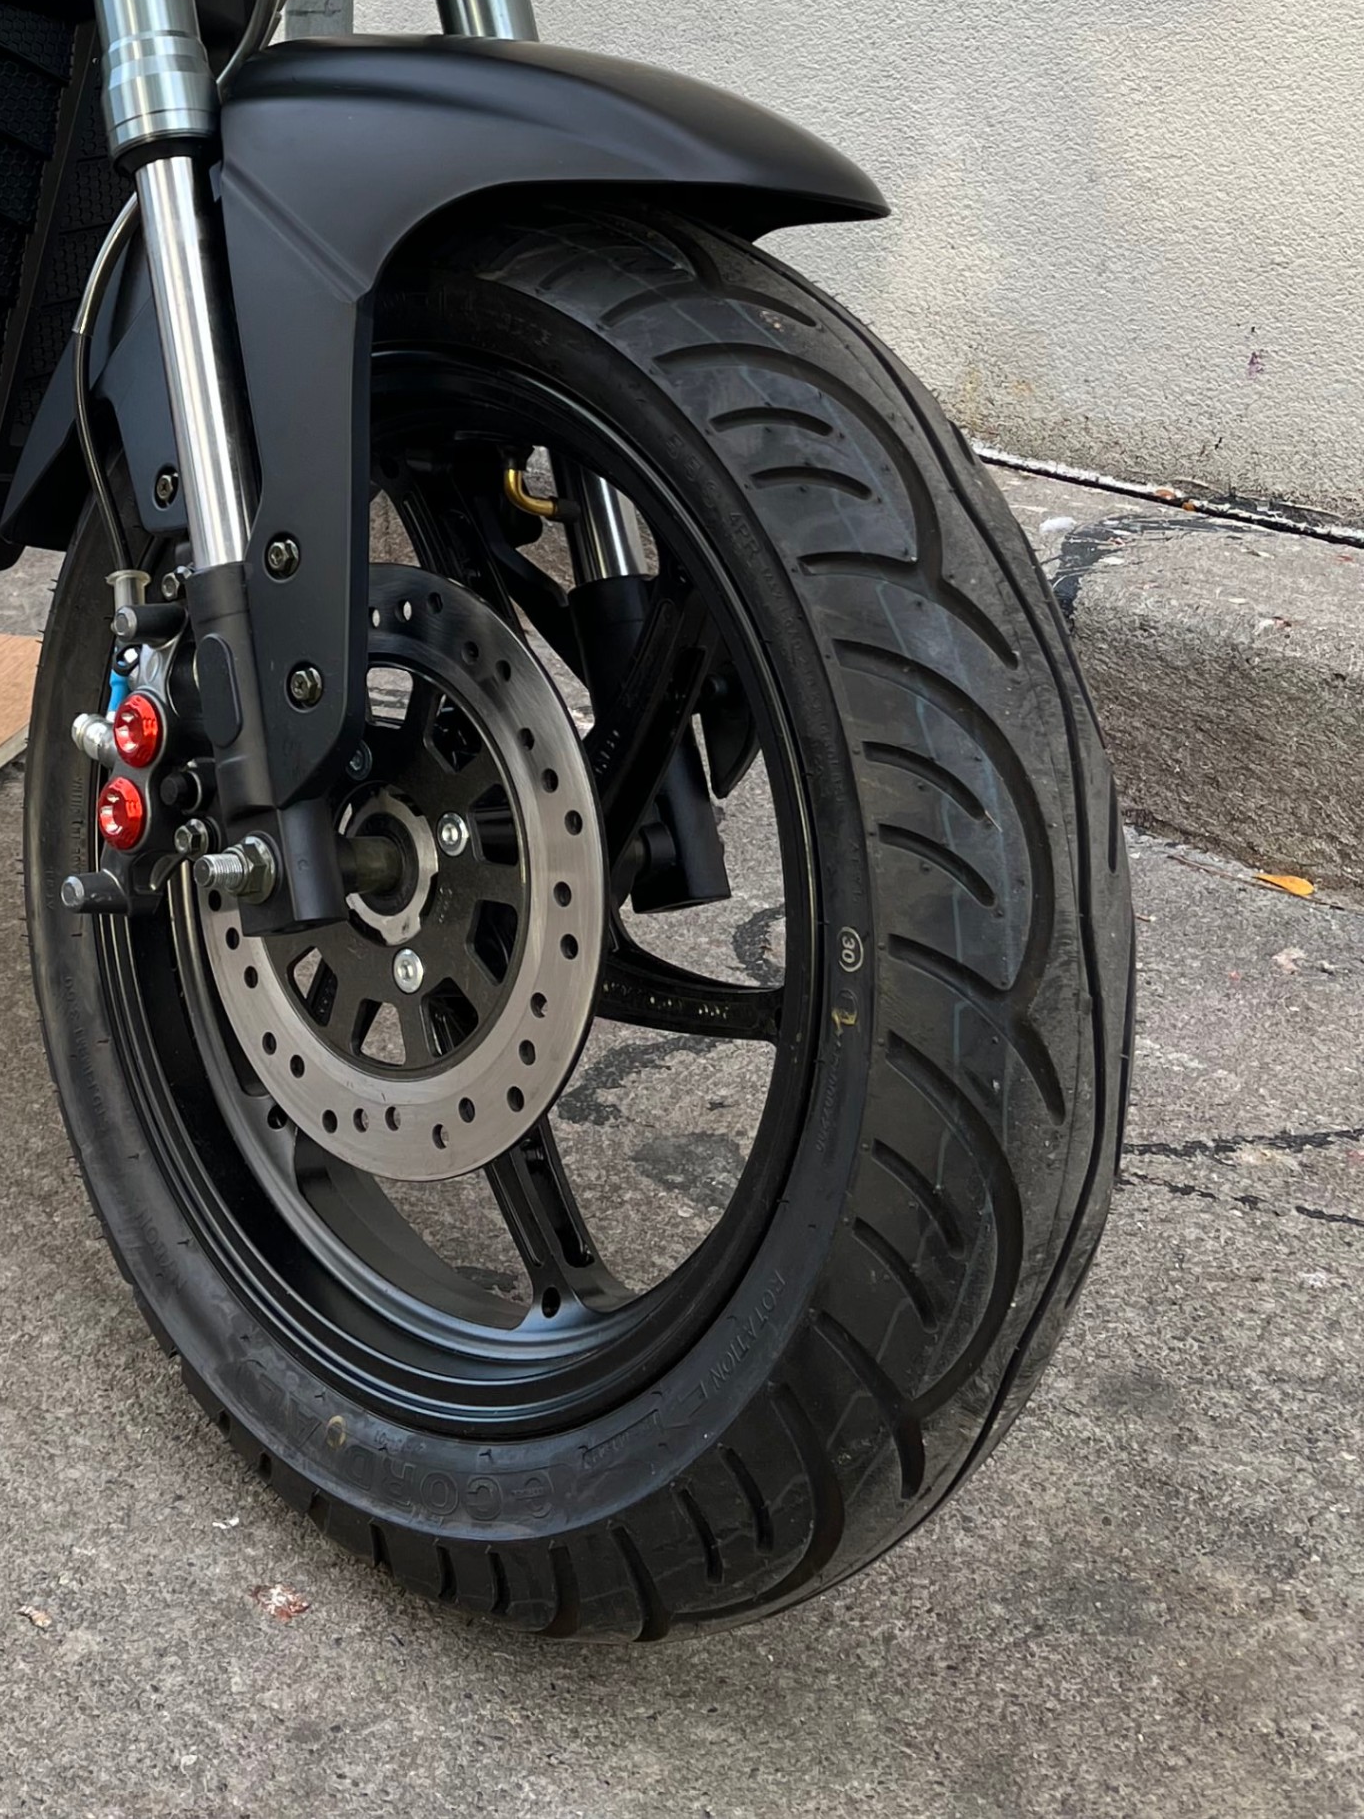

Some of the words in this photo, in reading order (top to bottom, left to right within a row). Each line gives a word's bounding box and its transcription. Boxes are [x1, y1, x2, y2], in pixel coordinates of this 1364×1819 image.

[840, 935, 857, 964] 30
[711, 1269, 787, 1394] ROTATION
[258, 1369, 504, 1521] CORDAL
